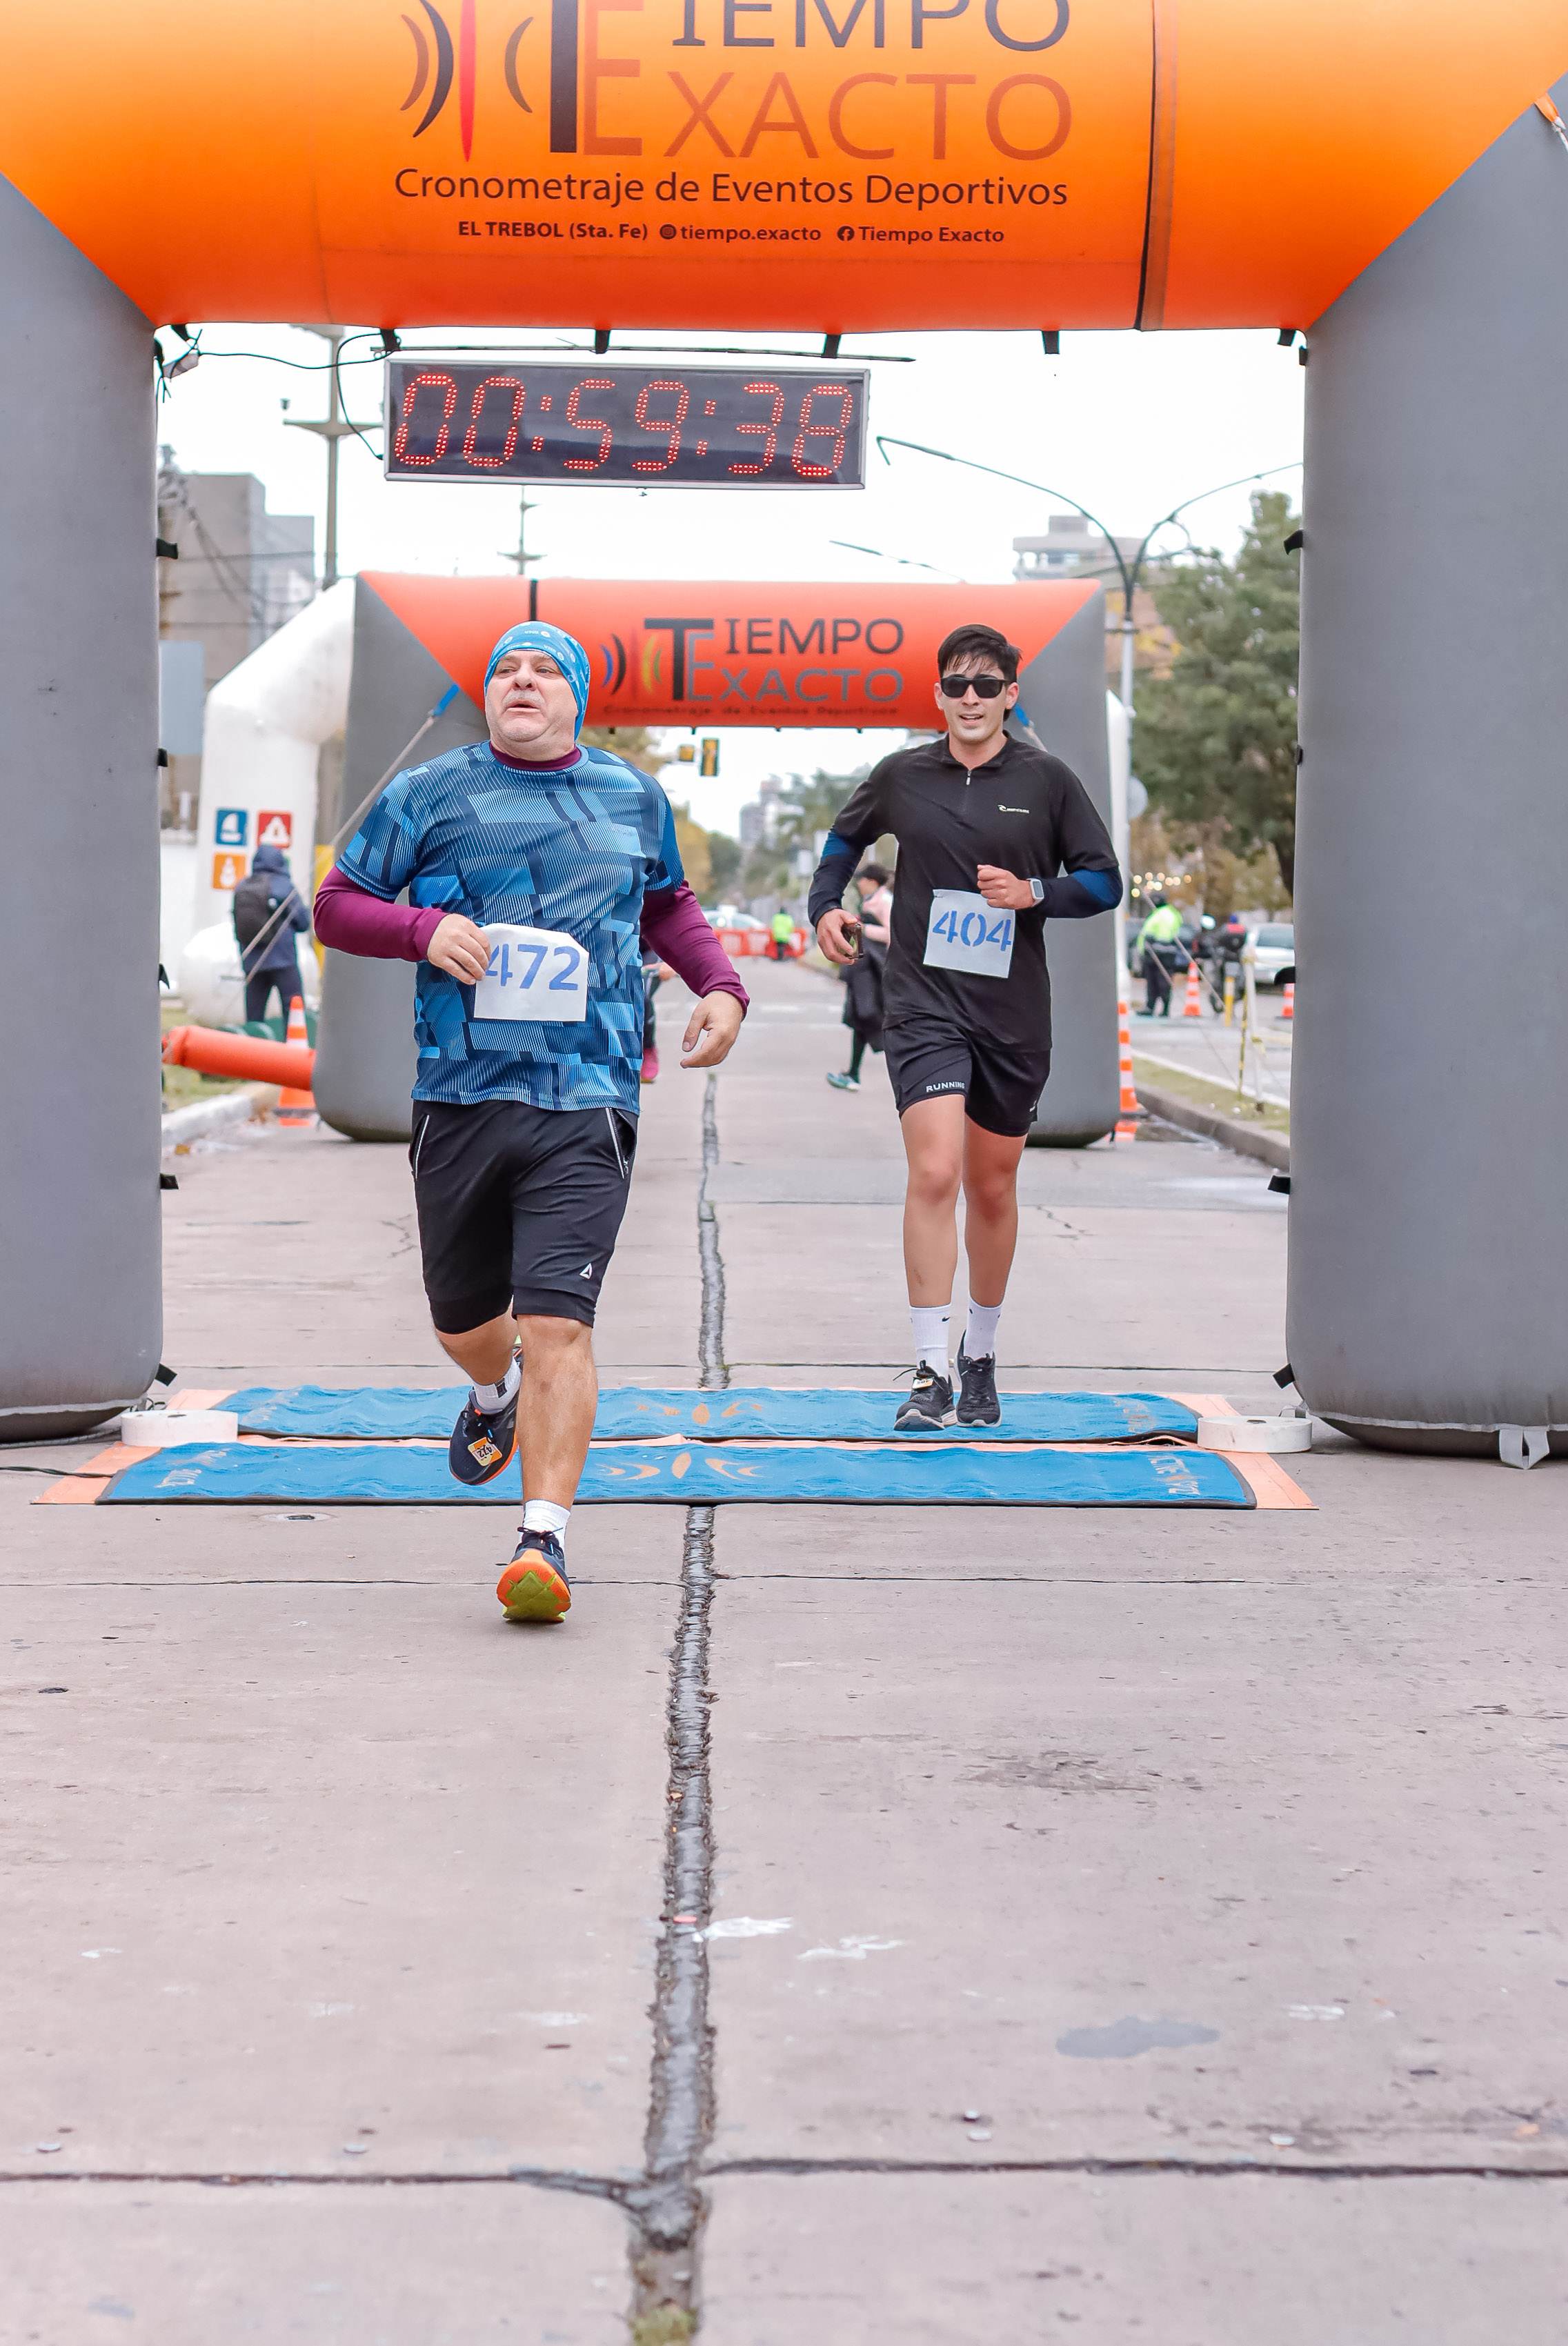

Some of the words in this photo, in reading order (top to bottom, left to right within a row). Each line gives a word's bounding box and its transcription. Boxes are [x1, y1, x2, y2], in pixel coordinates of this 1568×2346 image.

[395, 168, 644, 208] Cronometraje
[655, 171, 699, 202] de
[713, 173, 853, 203] Eventos
[866, 174, 1068, 211] Deportivos
[458, 221, 482, 237] EL
[486, 221, 564, 239] TREBOL
[569, 223, 614, 240] (Sta.
[619, 223, 648, 241] Fe)
[680, 225, 822, 243] tiempo.exacto
[857, 226, 933, 245] Tiempo
[939, 226, 1005, 243] Exacto
[393, 372, 855, 477] 00:59:38
[932, 910, 1012, 952] 404
[485, 943, 581, 991] 472
[926, 1081, 965, 1093] RUNNING
